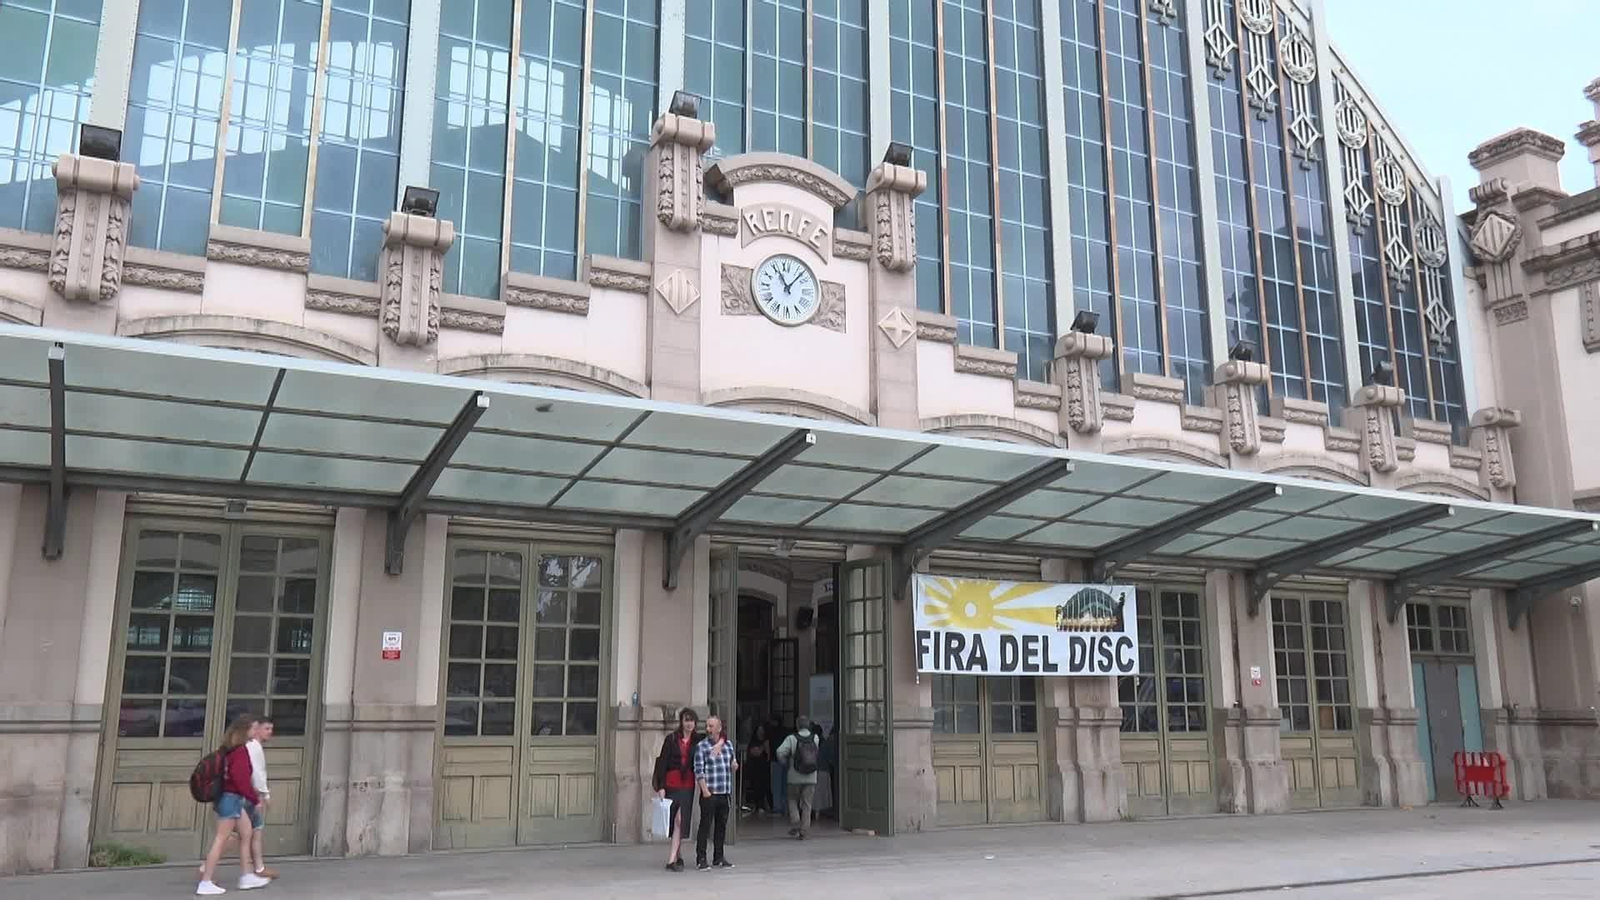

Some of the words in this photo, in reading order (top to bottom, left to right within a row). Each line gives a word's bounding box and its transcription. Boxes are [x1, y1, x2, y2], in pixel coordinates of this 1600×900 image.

[743, 208, 828, 249] RENFE
[916, 630, 988, 672] FIRA
[1000, 634, 1058, 673] DEL
[1069, 635, 1135, 673] DISC
